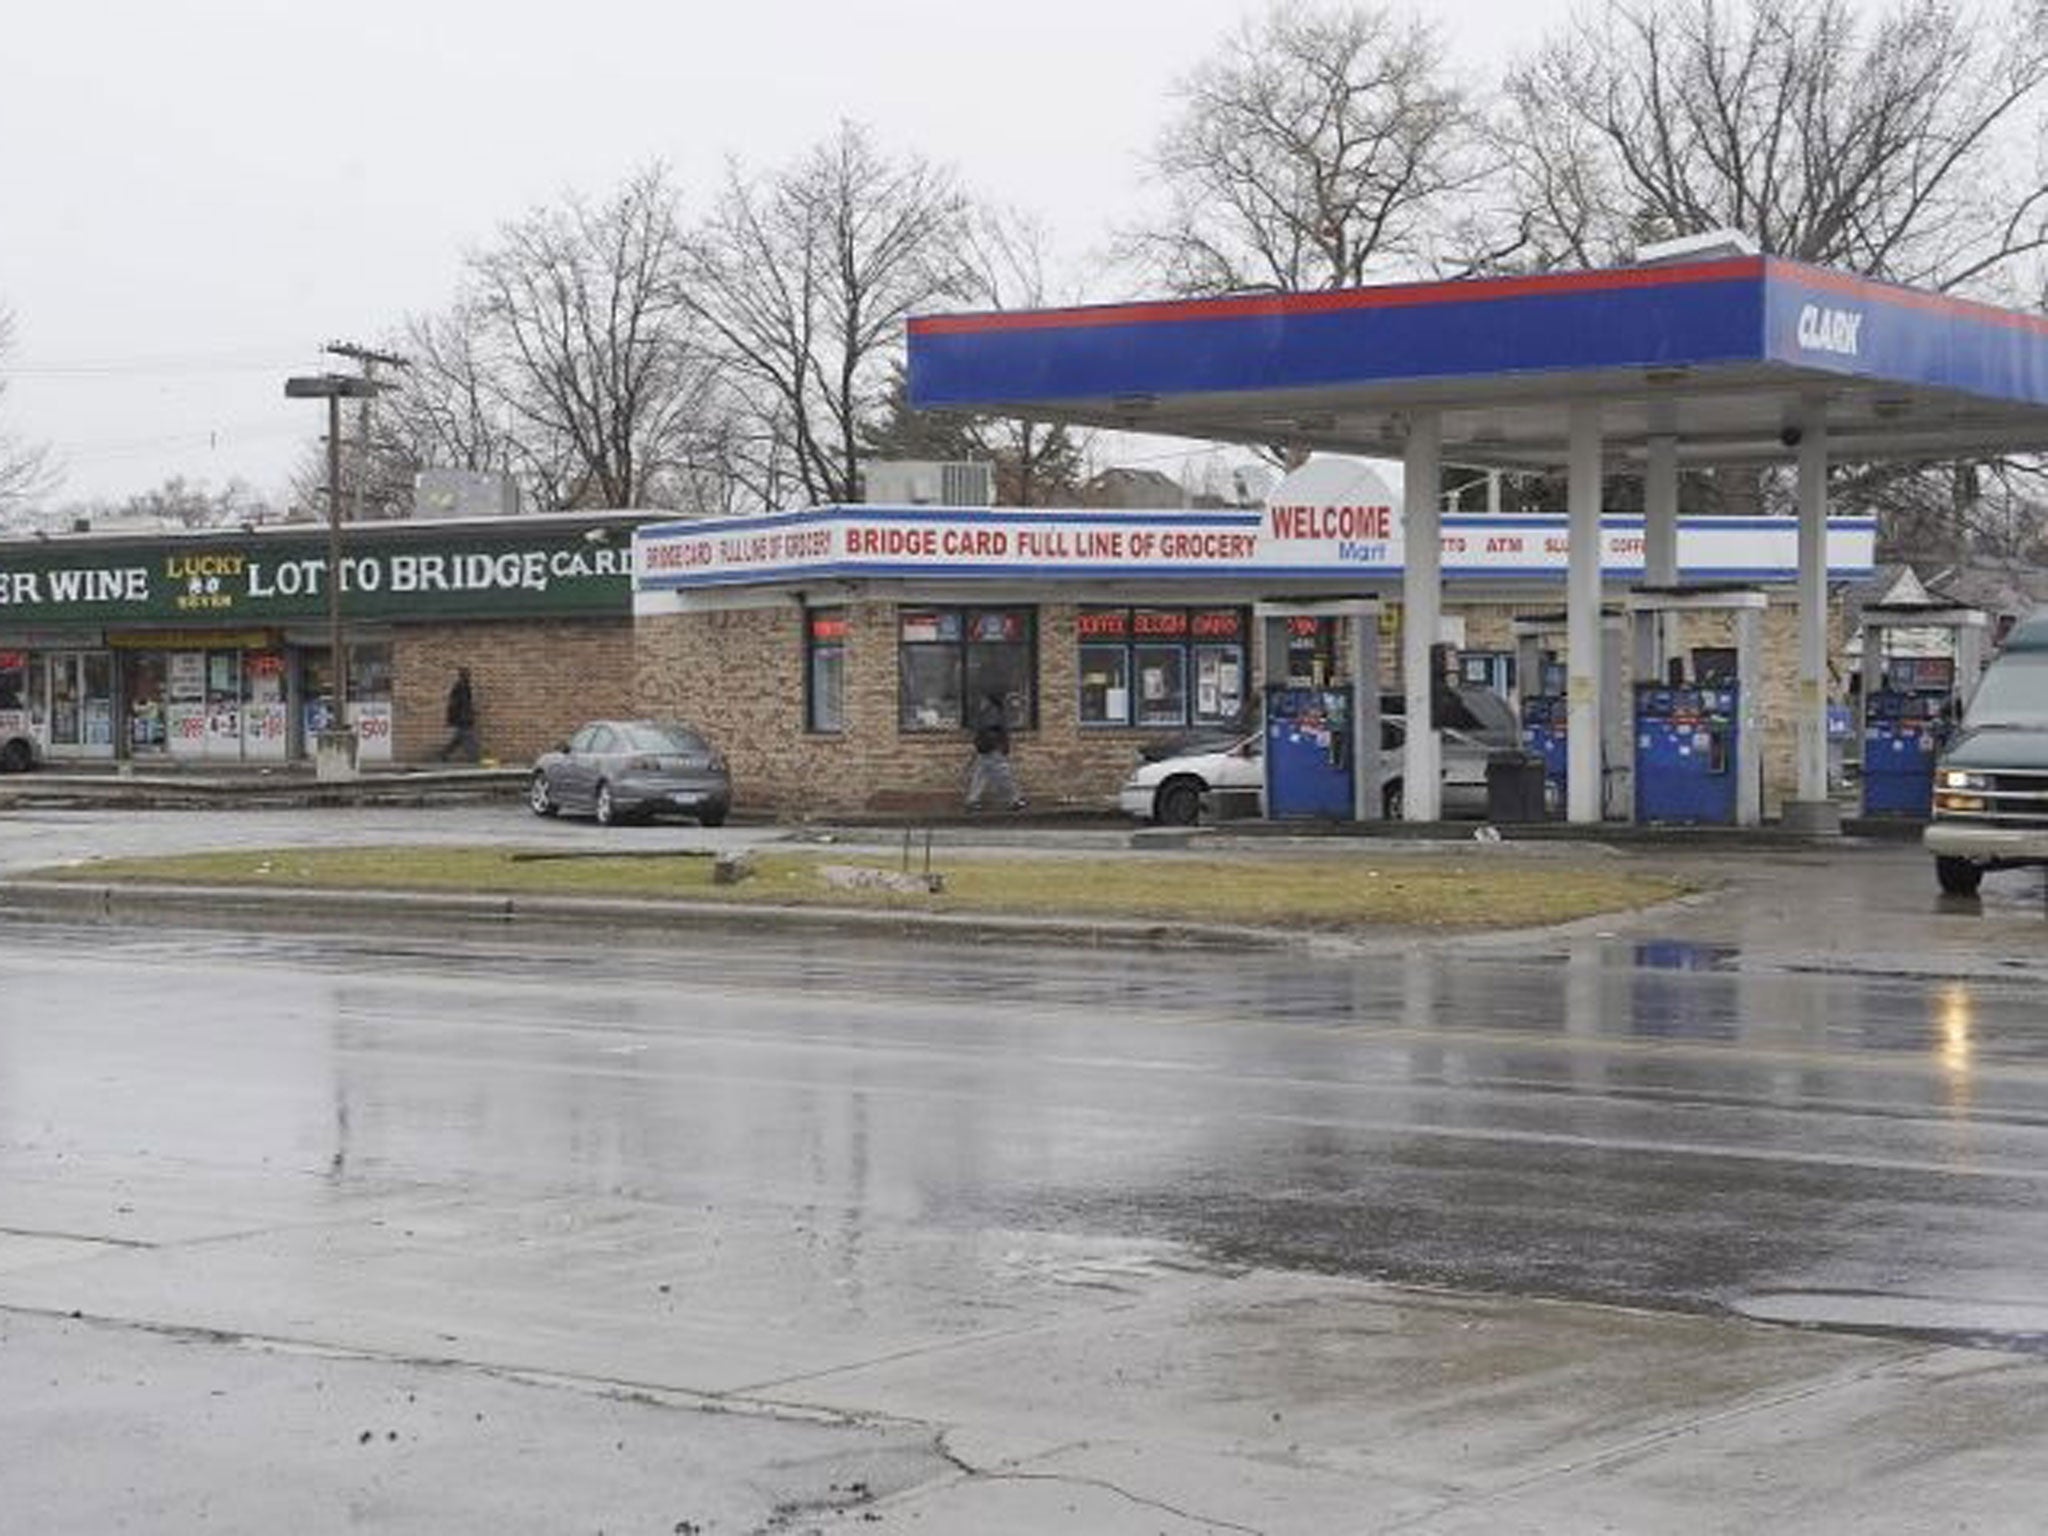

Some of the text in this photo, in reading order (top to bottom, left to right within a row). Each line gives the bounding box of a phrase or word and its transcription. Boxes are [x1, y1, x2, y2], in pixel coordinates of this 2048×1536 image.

[1271, 505, 1391, 540] WELCOME
[846, 528, 1257, 558] BRIDGE CARD FULL LINE OF GROCERY
[1339, 542, 1386, 561] Mart
[1486, 537, 1524, 552] ATM
[166, 556, 245, 579] LUCKY
[390, 552, 547, 590] BRIDGE
[48, 568, 149, 601] WINE
